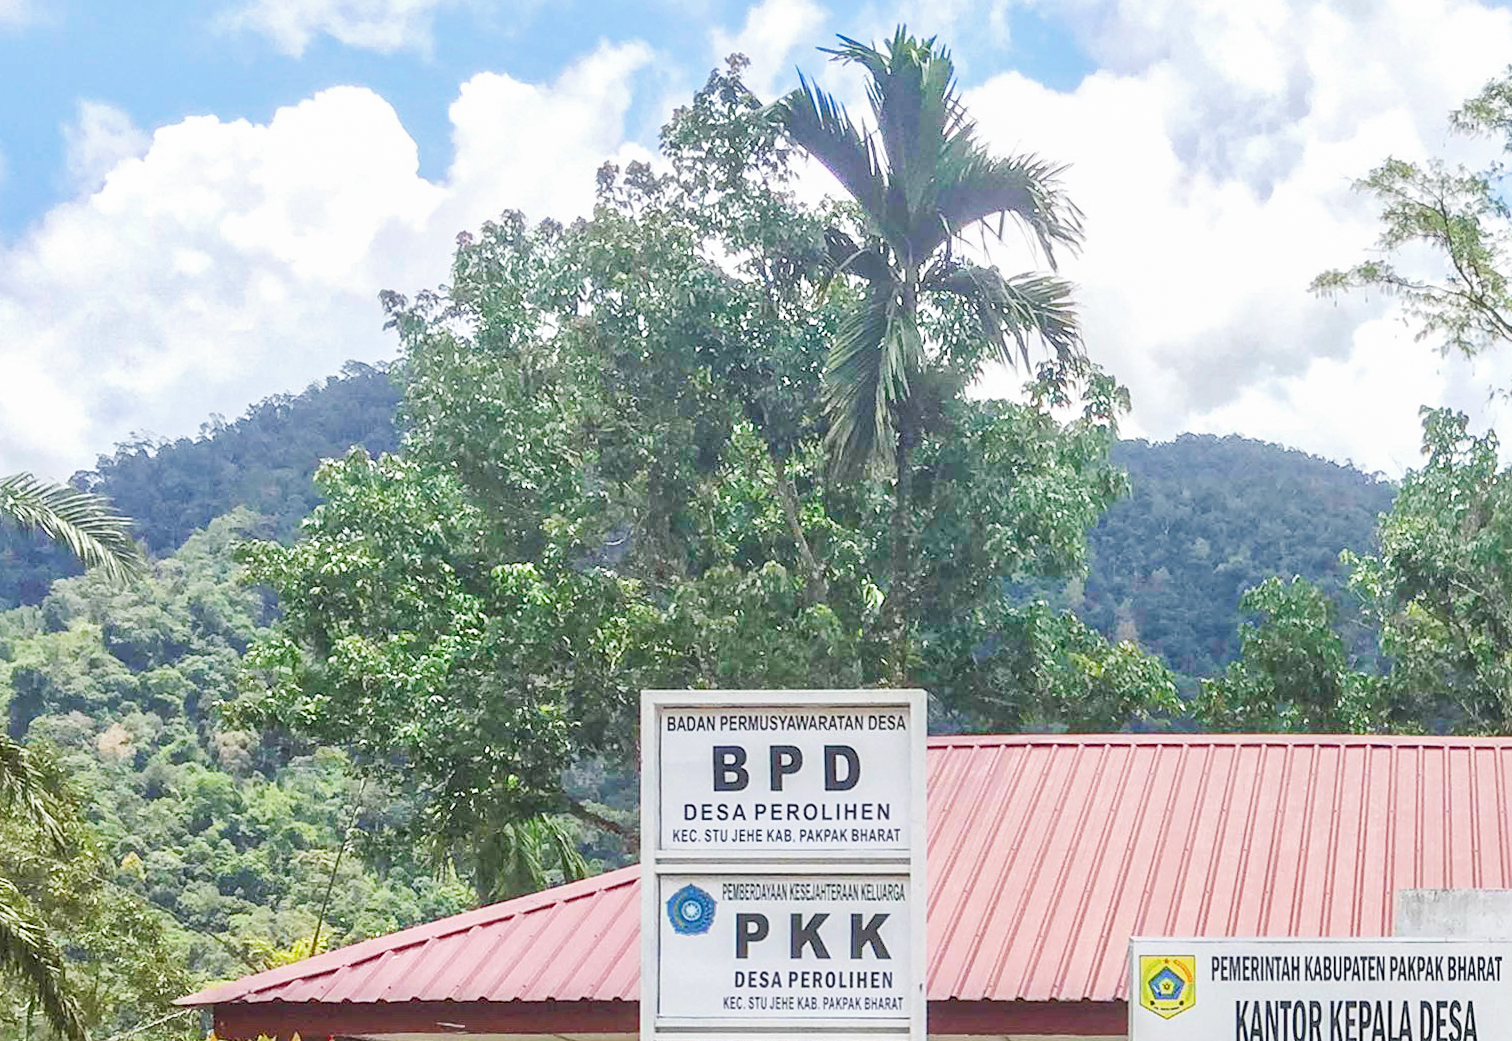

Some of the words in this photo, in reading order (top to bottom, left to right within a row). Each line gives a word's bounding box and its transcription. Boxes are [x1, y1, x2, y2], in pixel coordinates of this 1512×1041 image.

[667, 715, 716, 732] BADAN
[720, 714, 864, 732] PERMUSYAWARATAN
[868, 714, 907, 732] DESA
[684, 803, 747, 821] DESA
[754, 803, 890, 821] PEROLIHEN
[672, 828, 701, 843] KEC.
[704, 828, 728, 843] STU
[731, 828, 763, 843] JEHE
[766, 828, 797, 843] KAB.
[799, 828, 848, 842] PAKPAK
[851, 828, 901, 842] BHARAT
[722, 882, 788, 901] PEMBERDAYAAN
[789, 883, 859, 901] KESEJAHTERAAN
[861, 883, 906, 902] KELUARGA
[1211, 955, 1301, 982] PEMERINTAH
[1304, 955, 1386, 982] KABUPATEN
[1389, 955, 1444, 982] PAKPAK
[1447, 955, 1503, 982] BHARAT
[734, 970, 783, 989] DESA
[788, 971, 893, 989] PEROLIHEN
[723, 996, 746, 1010] KEC.
[748, 996, 767, 1010] STU
[769, 996, 794, 1010] JEHE
[797, 996, 821, 1010] KAB.
[823, 996, 862, 1010] PAKPAK
[864, 996, 904, 1010] BHARAT
